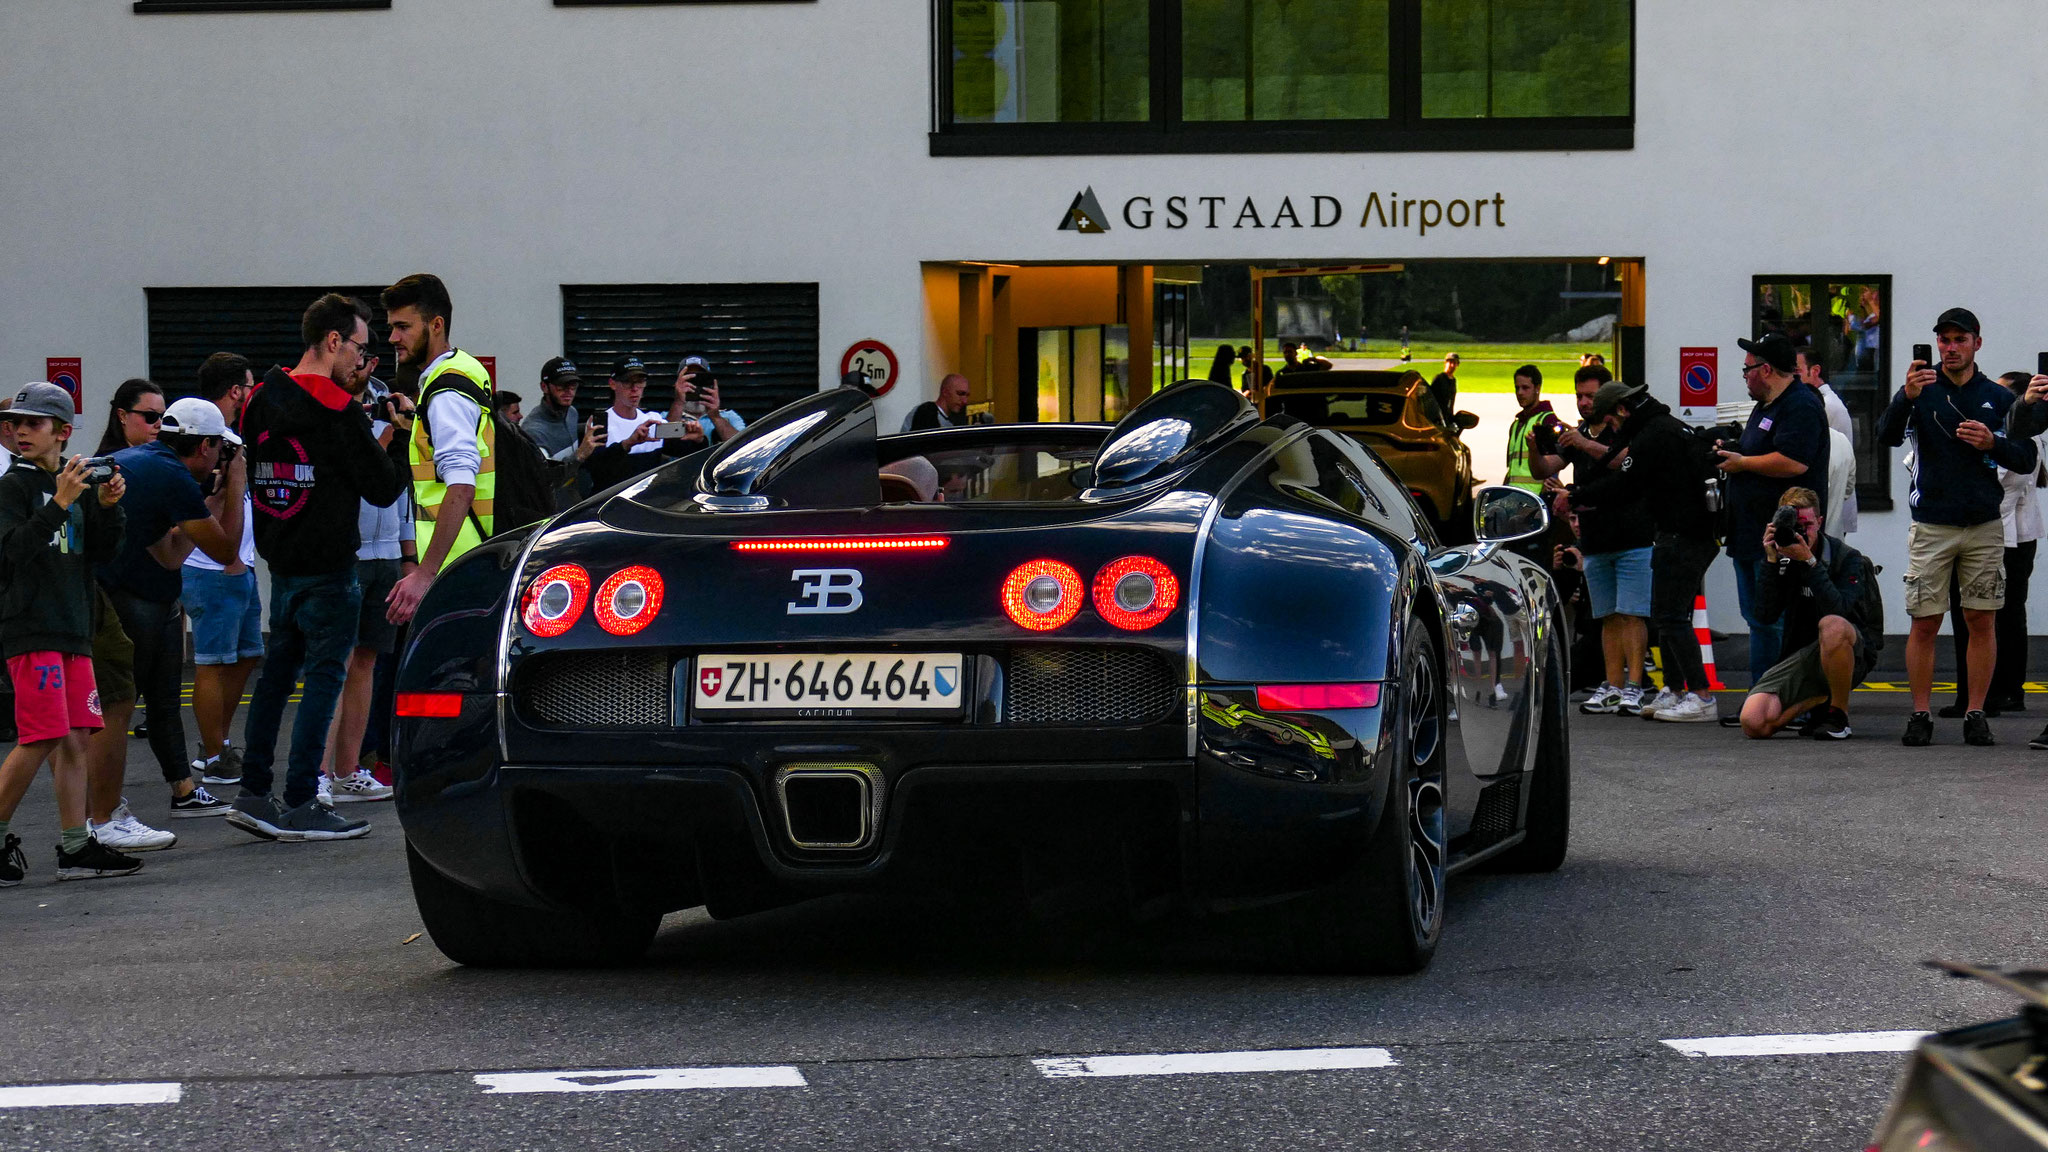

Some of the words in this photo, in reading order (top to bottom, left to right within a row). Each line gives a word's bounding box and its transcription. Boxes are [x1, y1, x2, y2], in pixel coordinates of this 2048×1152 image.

[1122, 195, 1343, 230] GSTAAD
[1359, 191, 1506, 237] Airport
[35, 664, 63, 690] 73
